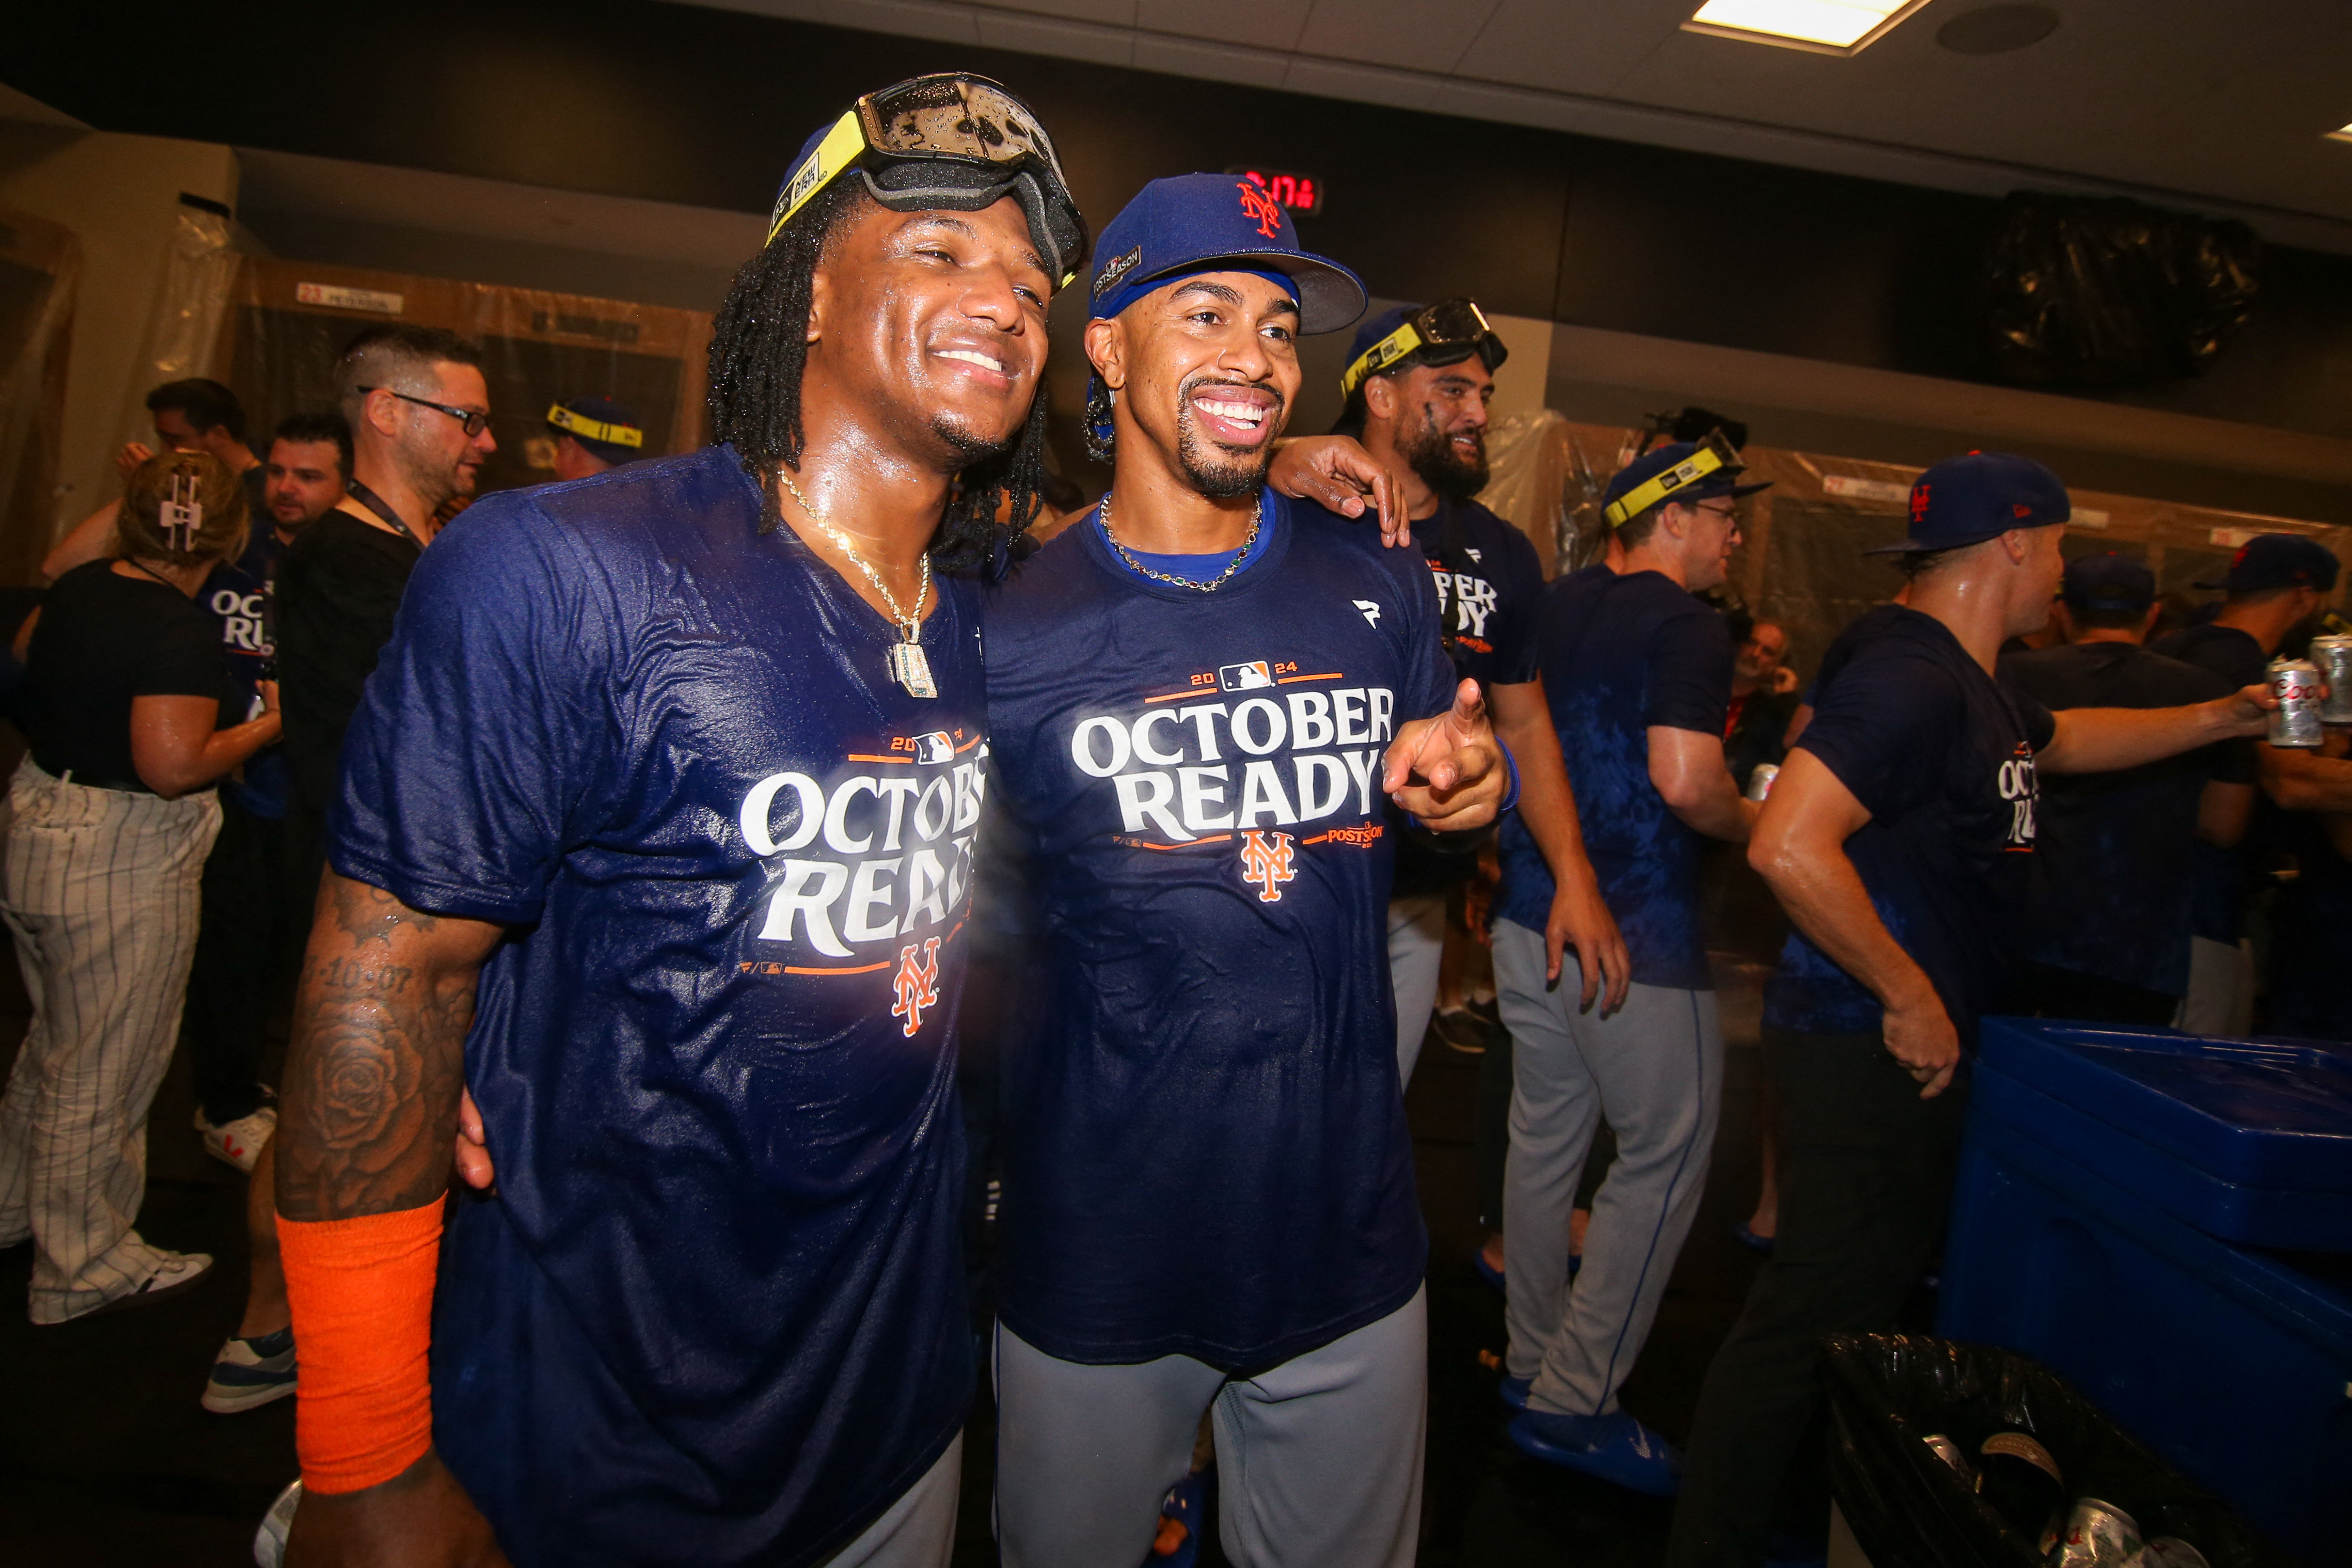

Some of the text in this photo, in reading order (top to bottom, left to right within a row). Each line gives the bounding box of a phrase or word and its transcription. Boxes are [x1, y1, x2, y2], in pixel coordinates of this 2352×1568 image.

[794, 172, 815, 200] ERA
[795, 163, 815, 191] NEW
[1190, 661, 1298, 686] 20 24
[890, 737, 915, 751] 20
[1071, 687, 1394, 778] OCTOBER
[1113, 749, 1380, 841] READY
